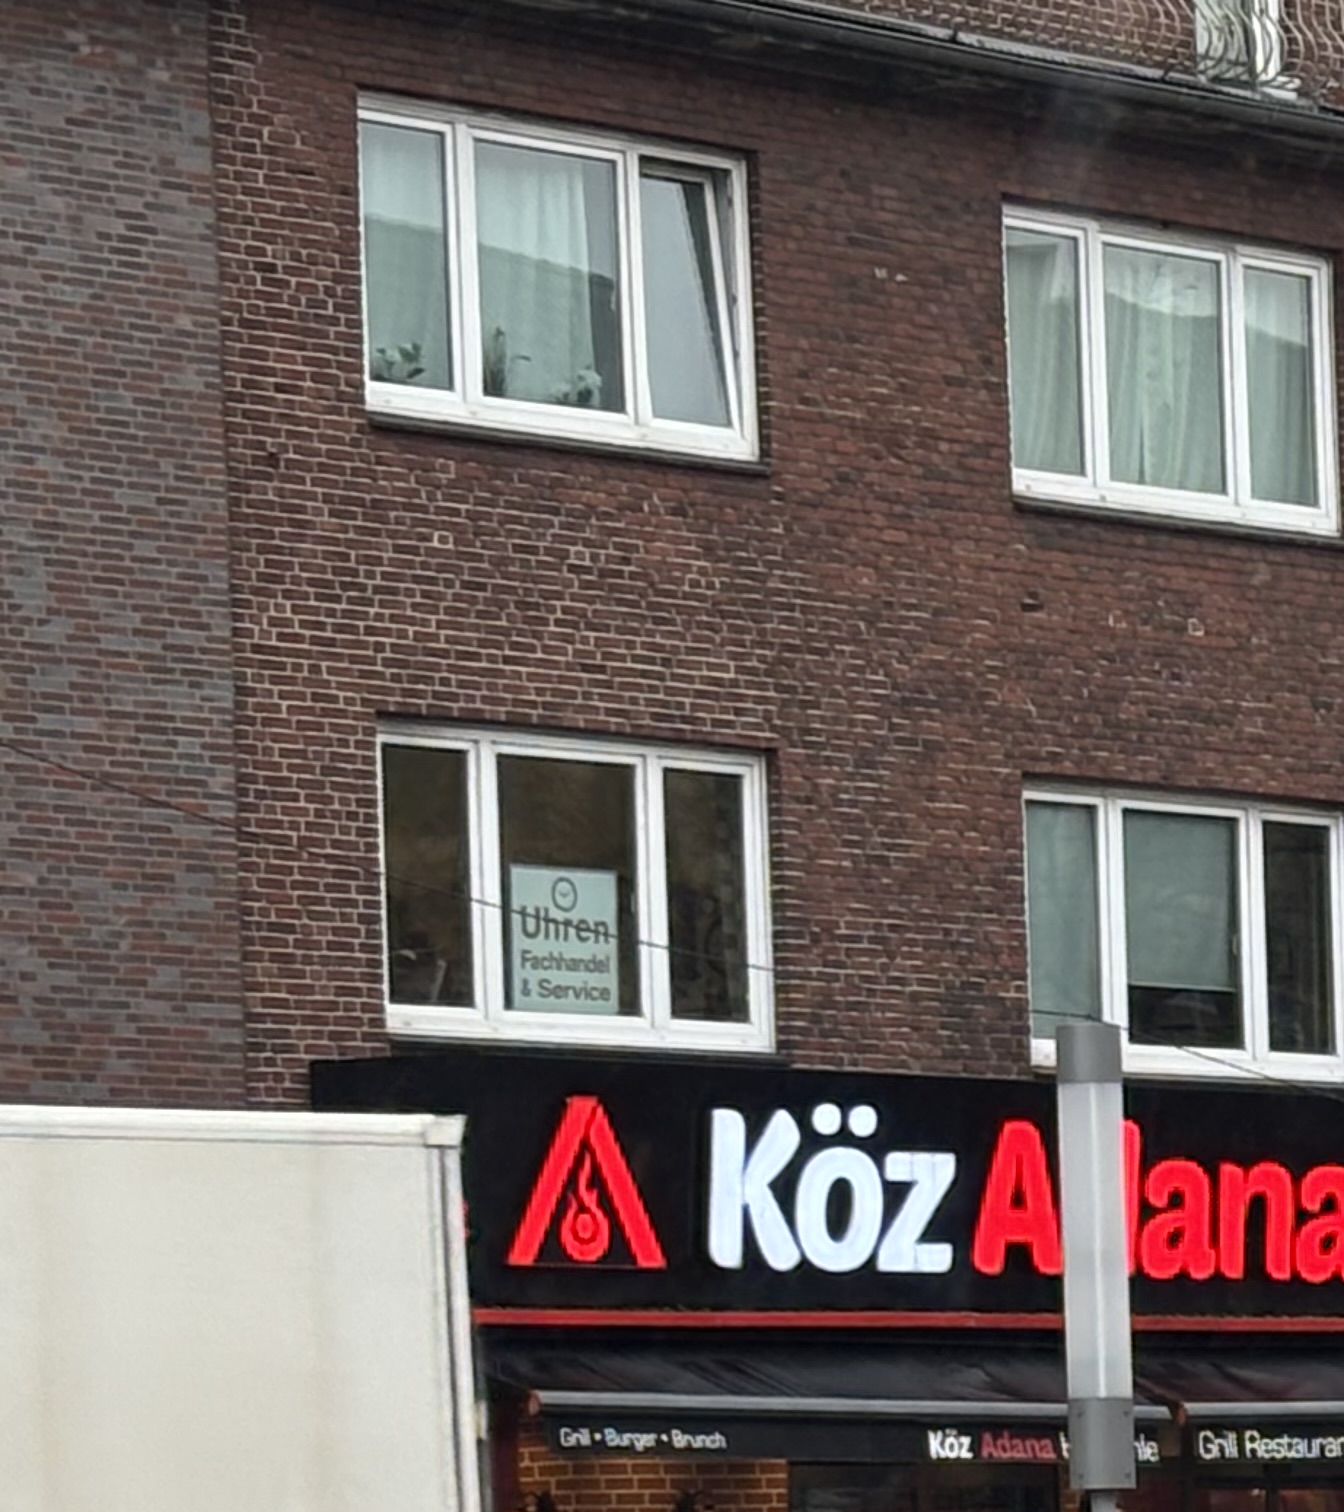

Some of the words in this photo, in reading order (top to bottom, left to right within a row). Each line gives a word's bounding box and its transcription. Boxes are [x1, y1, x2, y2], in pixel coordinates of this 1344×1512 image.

[519, 905, 611, 944] Uhren
[520, 949, 611, 975] Fachhandel
[520, 979, 532, 997] &
[537, 978, 611, 1002] Service
[559, 1428, 591, 1448] Grill
[604, 1428, 657, 1451] Burger
[671, 1428, 727, 1449] Brunch
[927, 1428, 974, 1460] Köz
[980, 1431, 1057, 1460] Adana
[1198, 1428, 1239, 1459] Grill
